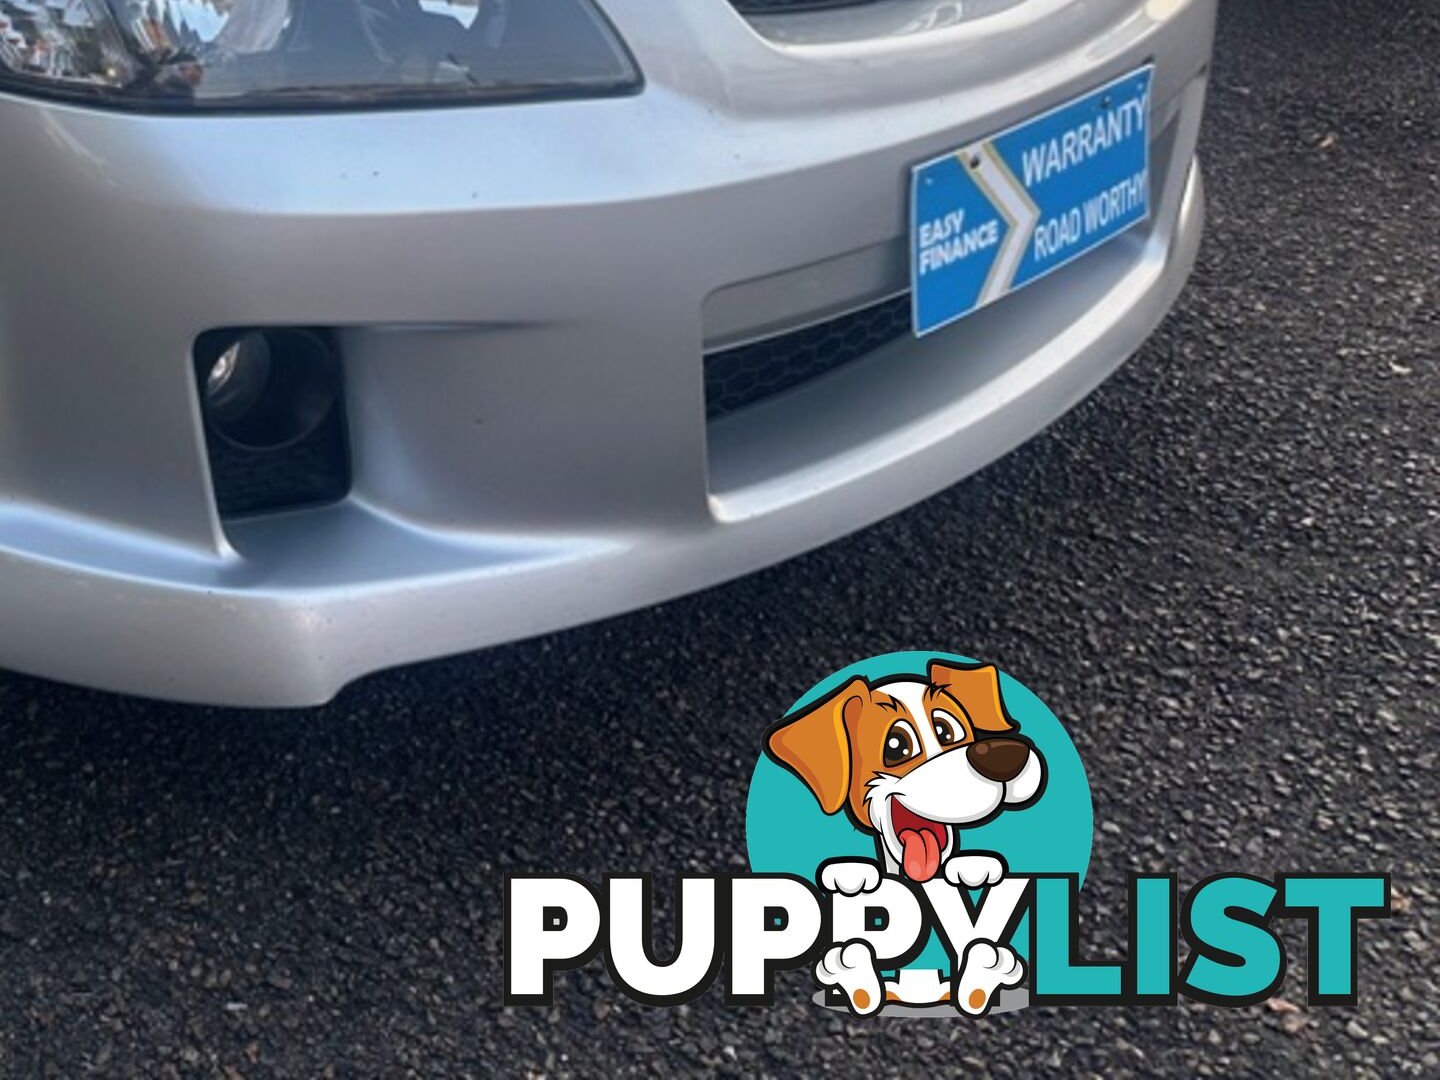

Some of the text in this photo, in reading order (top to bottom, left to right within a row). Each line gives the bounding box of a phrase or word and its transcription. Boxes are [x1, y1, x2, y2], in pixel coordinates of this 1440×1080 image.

[1021, 93, 1149, 188] WARRANTY
[919, 208, 965, 248] EASY
[919, 219, 1000, 276] FINANCE
[1034, 170, 1148, 262] ROAD WORTHY
